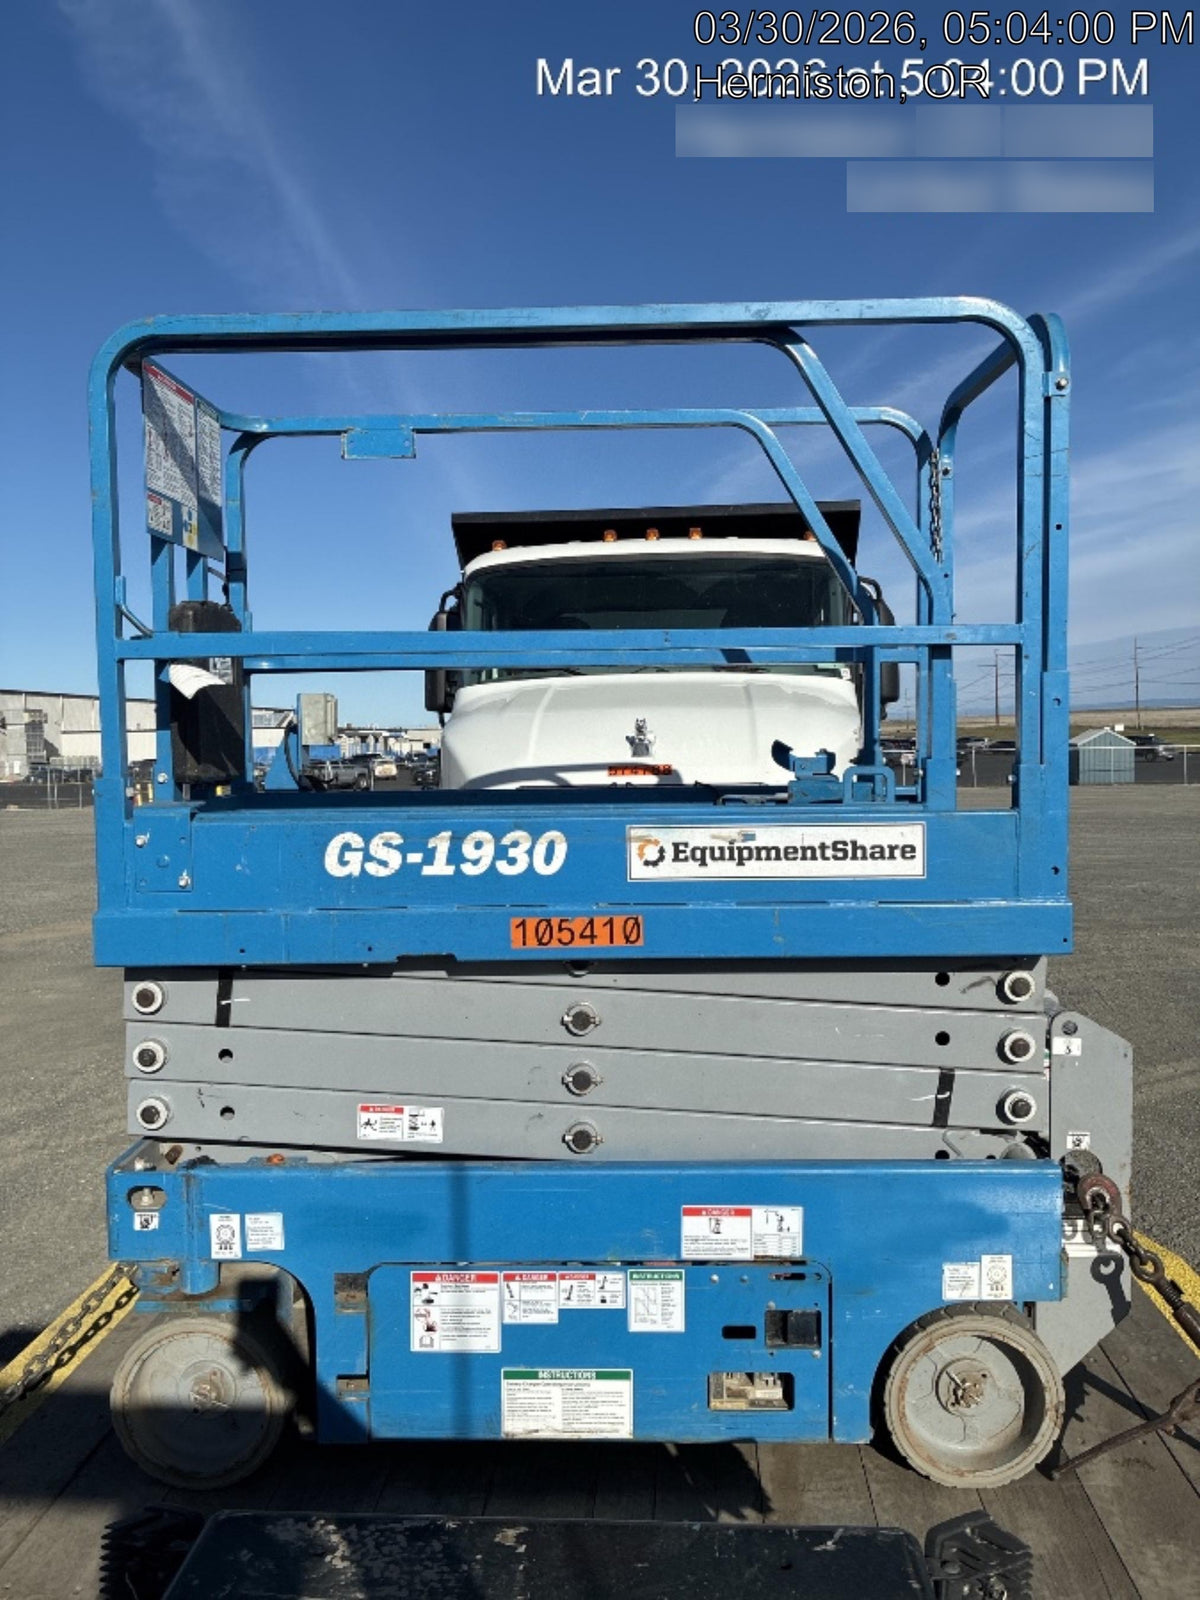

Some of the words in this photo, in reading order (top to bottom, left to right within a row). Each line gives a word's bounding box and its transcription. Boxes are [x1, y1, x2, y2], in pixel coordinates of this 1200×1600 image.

[324, 830, 568, 878] GS-1930
[671, 839, 917, 867] EquipmentShare
[515, 916, 641, 946] 105410
